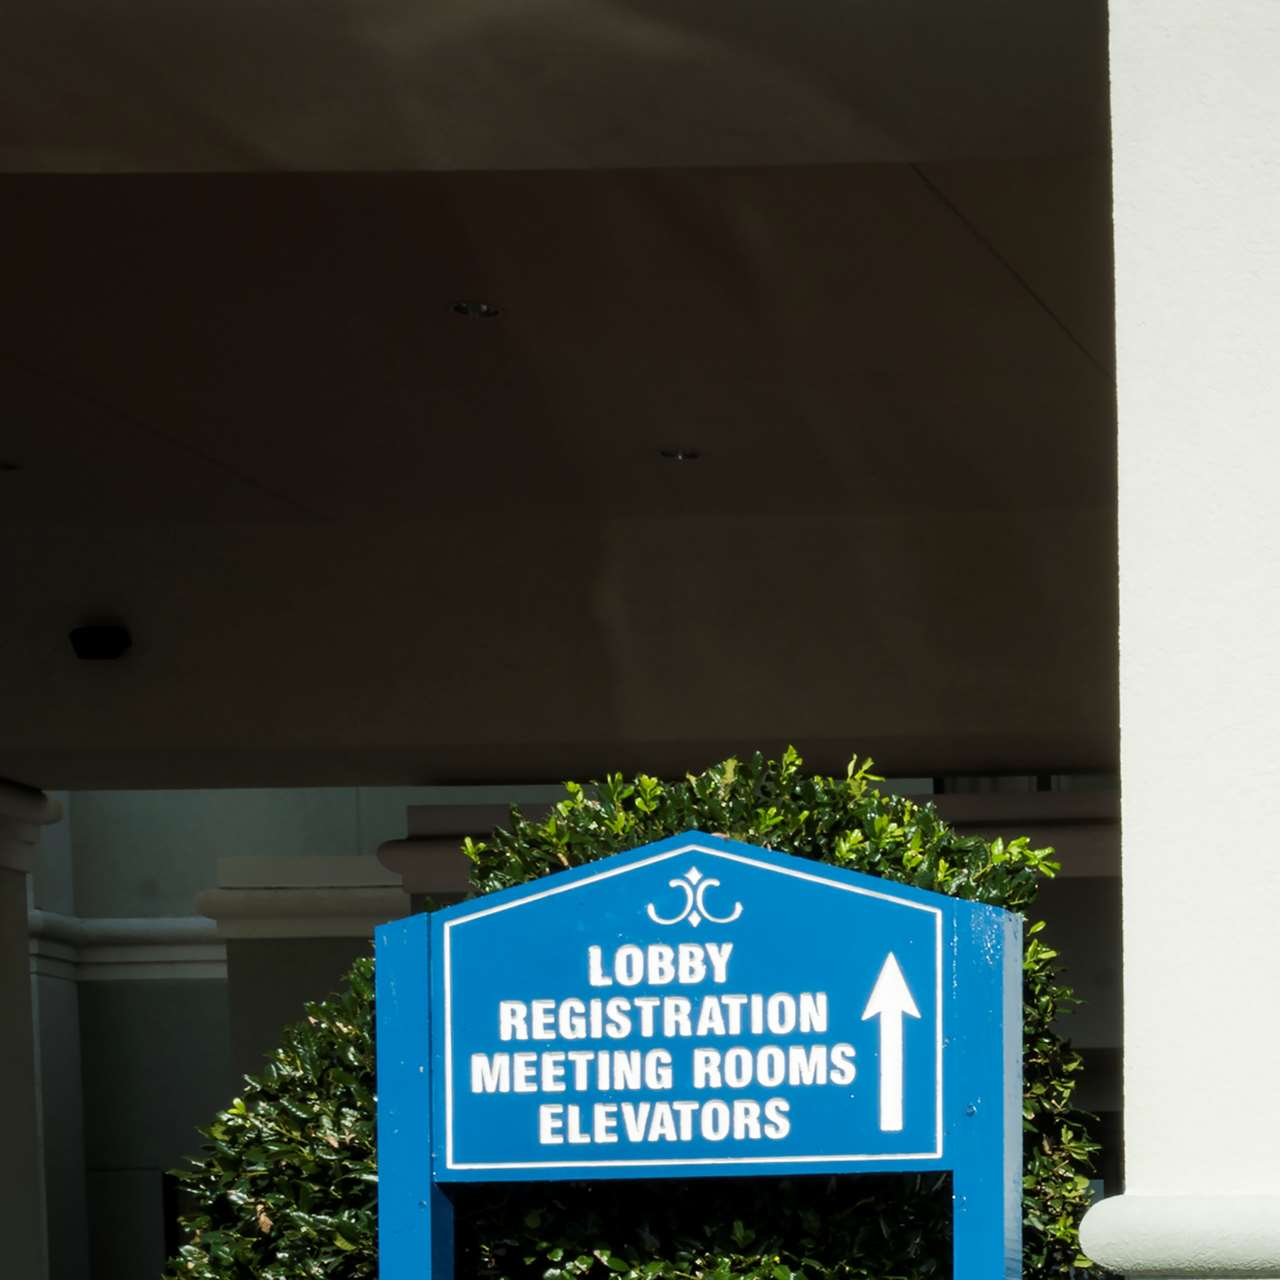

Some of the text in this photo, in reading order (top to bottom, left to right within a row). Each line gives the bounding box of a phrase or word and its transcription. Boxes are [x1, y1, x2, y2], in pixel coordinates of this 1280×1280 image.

[587, 942, 733, 987] LOBBY
[498, 991, 828, 1041] REGISTRATION
[471, 1043, 857, 1094] MEETING ROOMS
[538, 1097, 791, 1145] ELEVATORS
